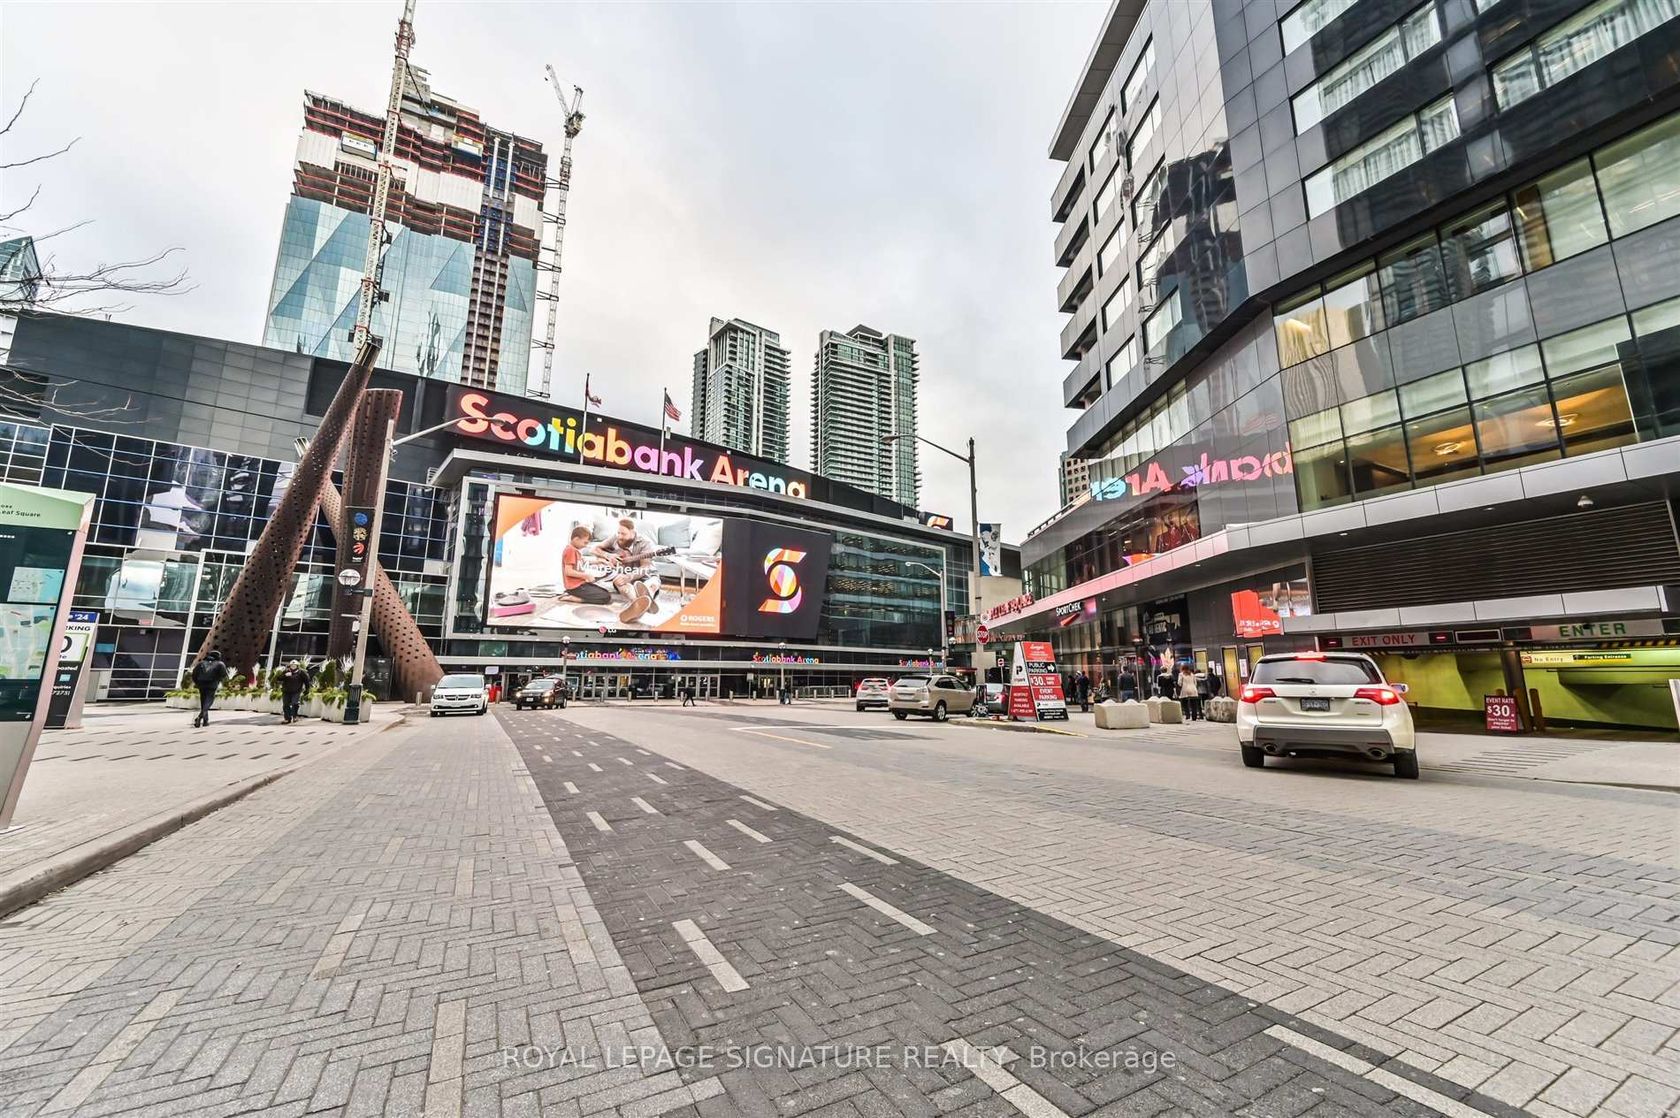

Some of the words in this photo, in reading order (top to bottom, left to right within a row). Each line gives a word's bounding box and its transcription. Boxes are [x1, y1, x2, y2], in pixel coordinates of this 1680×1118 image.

[456, 392, 705, 482] Scotiabank
[709, 454, 807, 500] Arena
[15, 510, 41, 518] Square
[977, 630, 988, 638] STOP
[1560, 622, 1627, 638] ENTER
[1352, 635, 1381, 647] EXIT
[1383, 633, 1416, 645] ONLY
